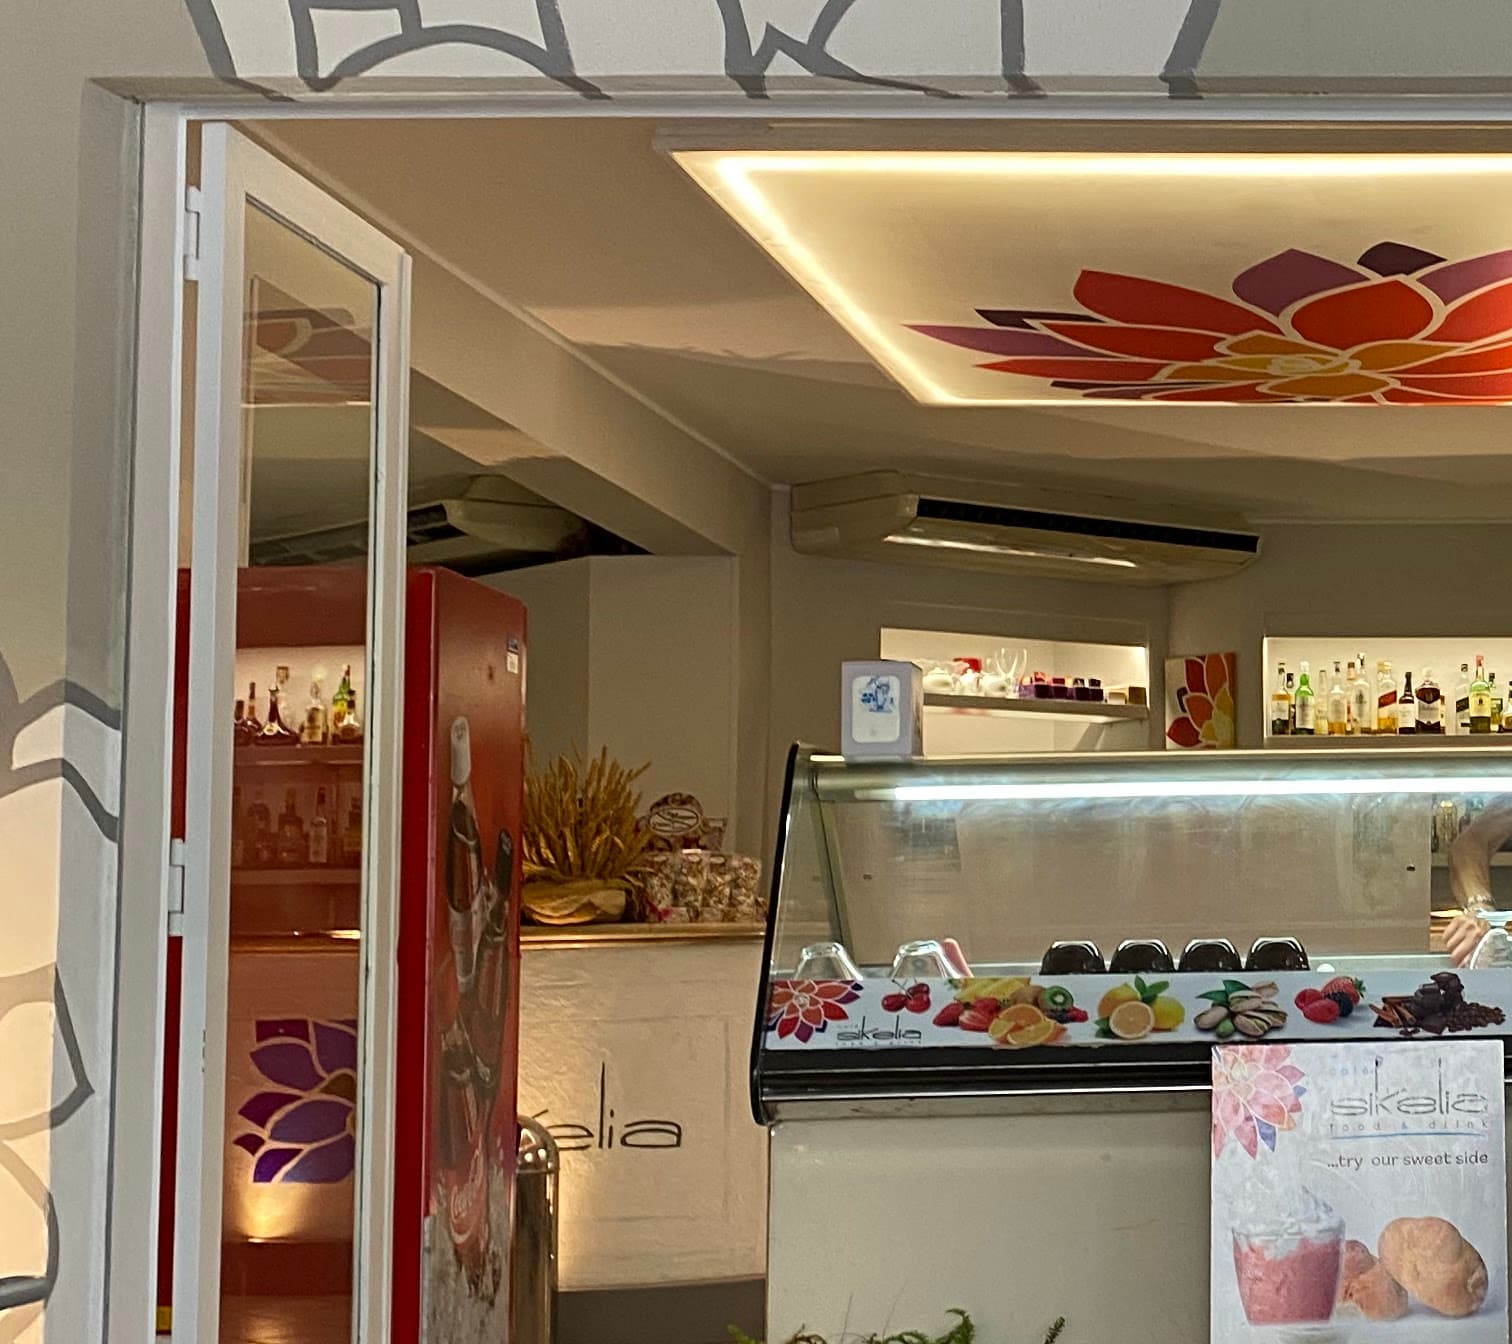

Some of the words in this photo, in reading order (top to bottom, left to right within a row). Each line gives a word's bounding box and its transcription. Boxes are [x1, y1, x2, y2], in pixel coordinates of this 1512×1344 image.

[1371, 1156, 1399, 1166] our
[1403, 1153, 1452, 1166] sweet
[1455, 1150, 1489, 1165] side
